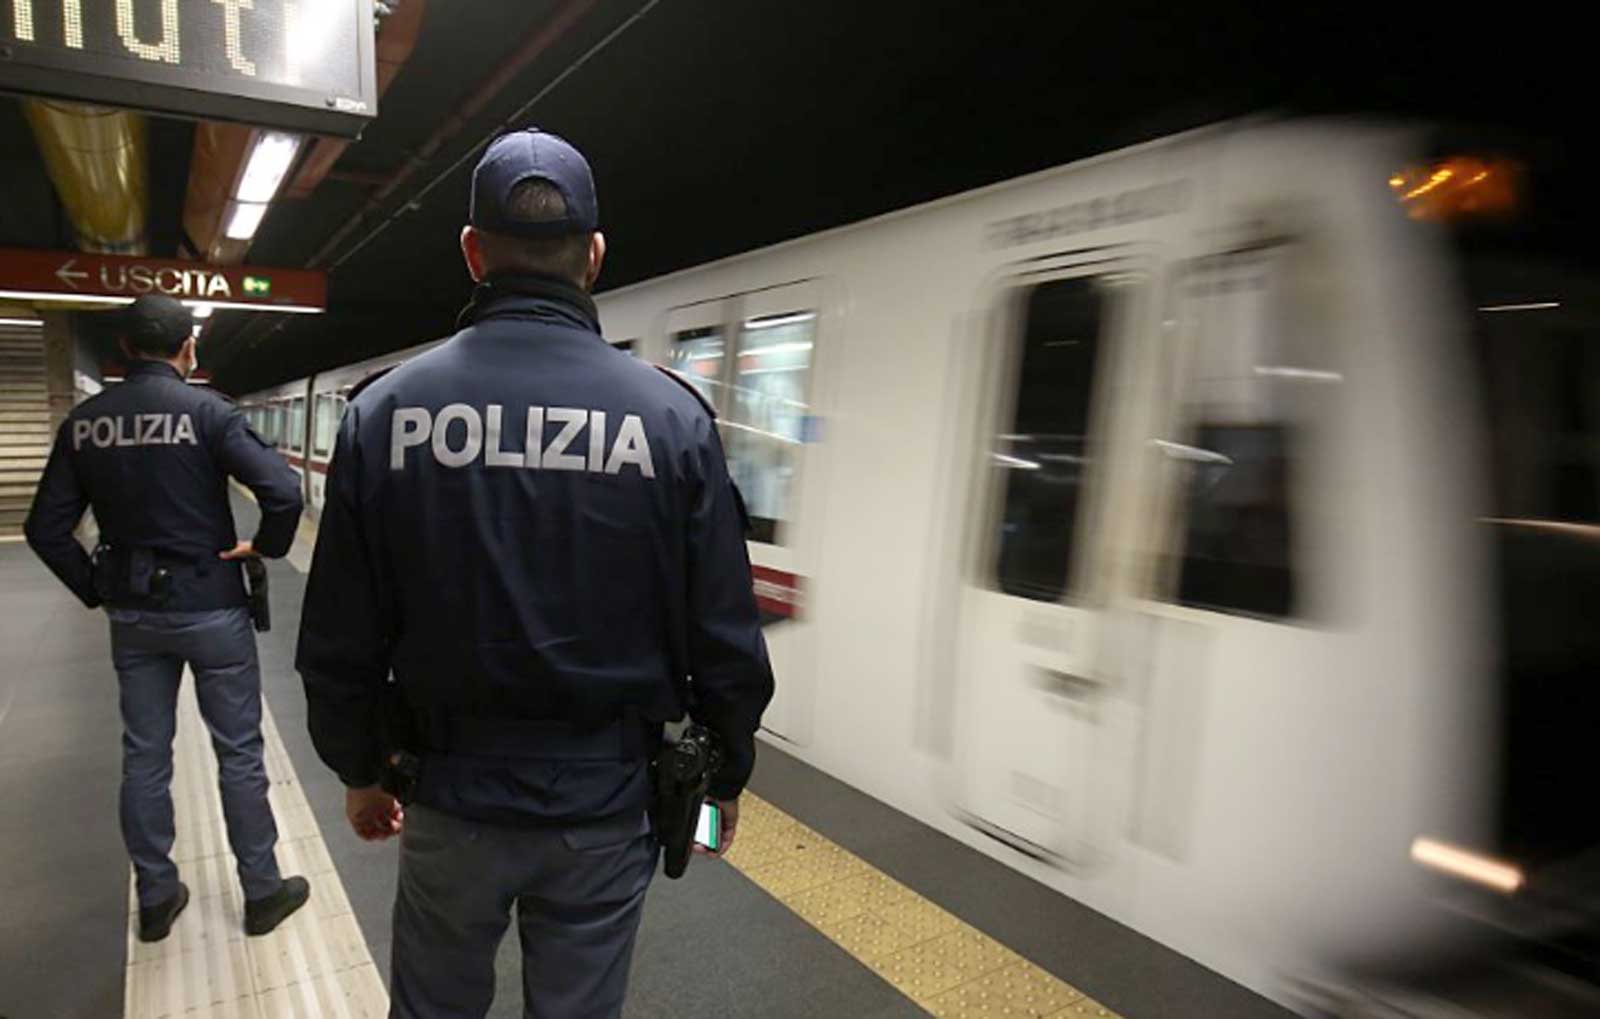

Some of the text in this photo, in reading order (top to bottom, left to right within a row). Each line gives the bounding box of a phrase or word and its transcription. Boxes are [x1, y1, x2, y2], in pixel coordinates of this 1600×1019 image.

[100, 264, 232, 298] USCITA
[73, 413, 198, 451] POLIZIA
[389, 402, 656, 479] POLIZIA
